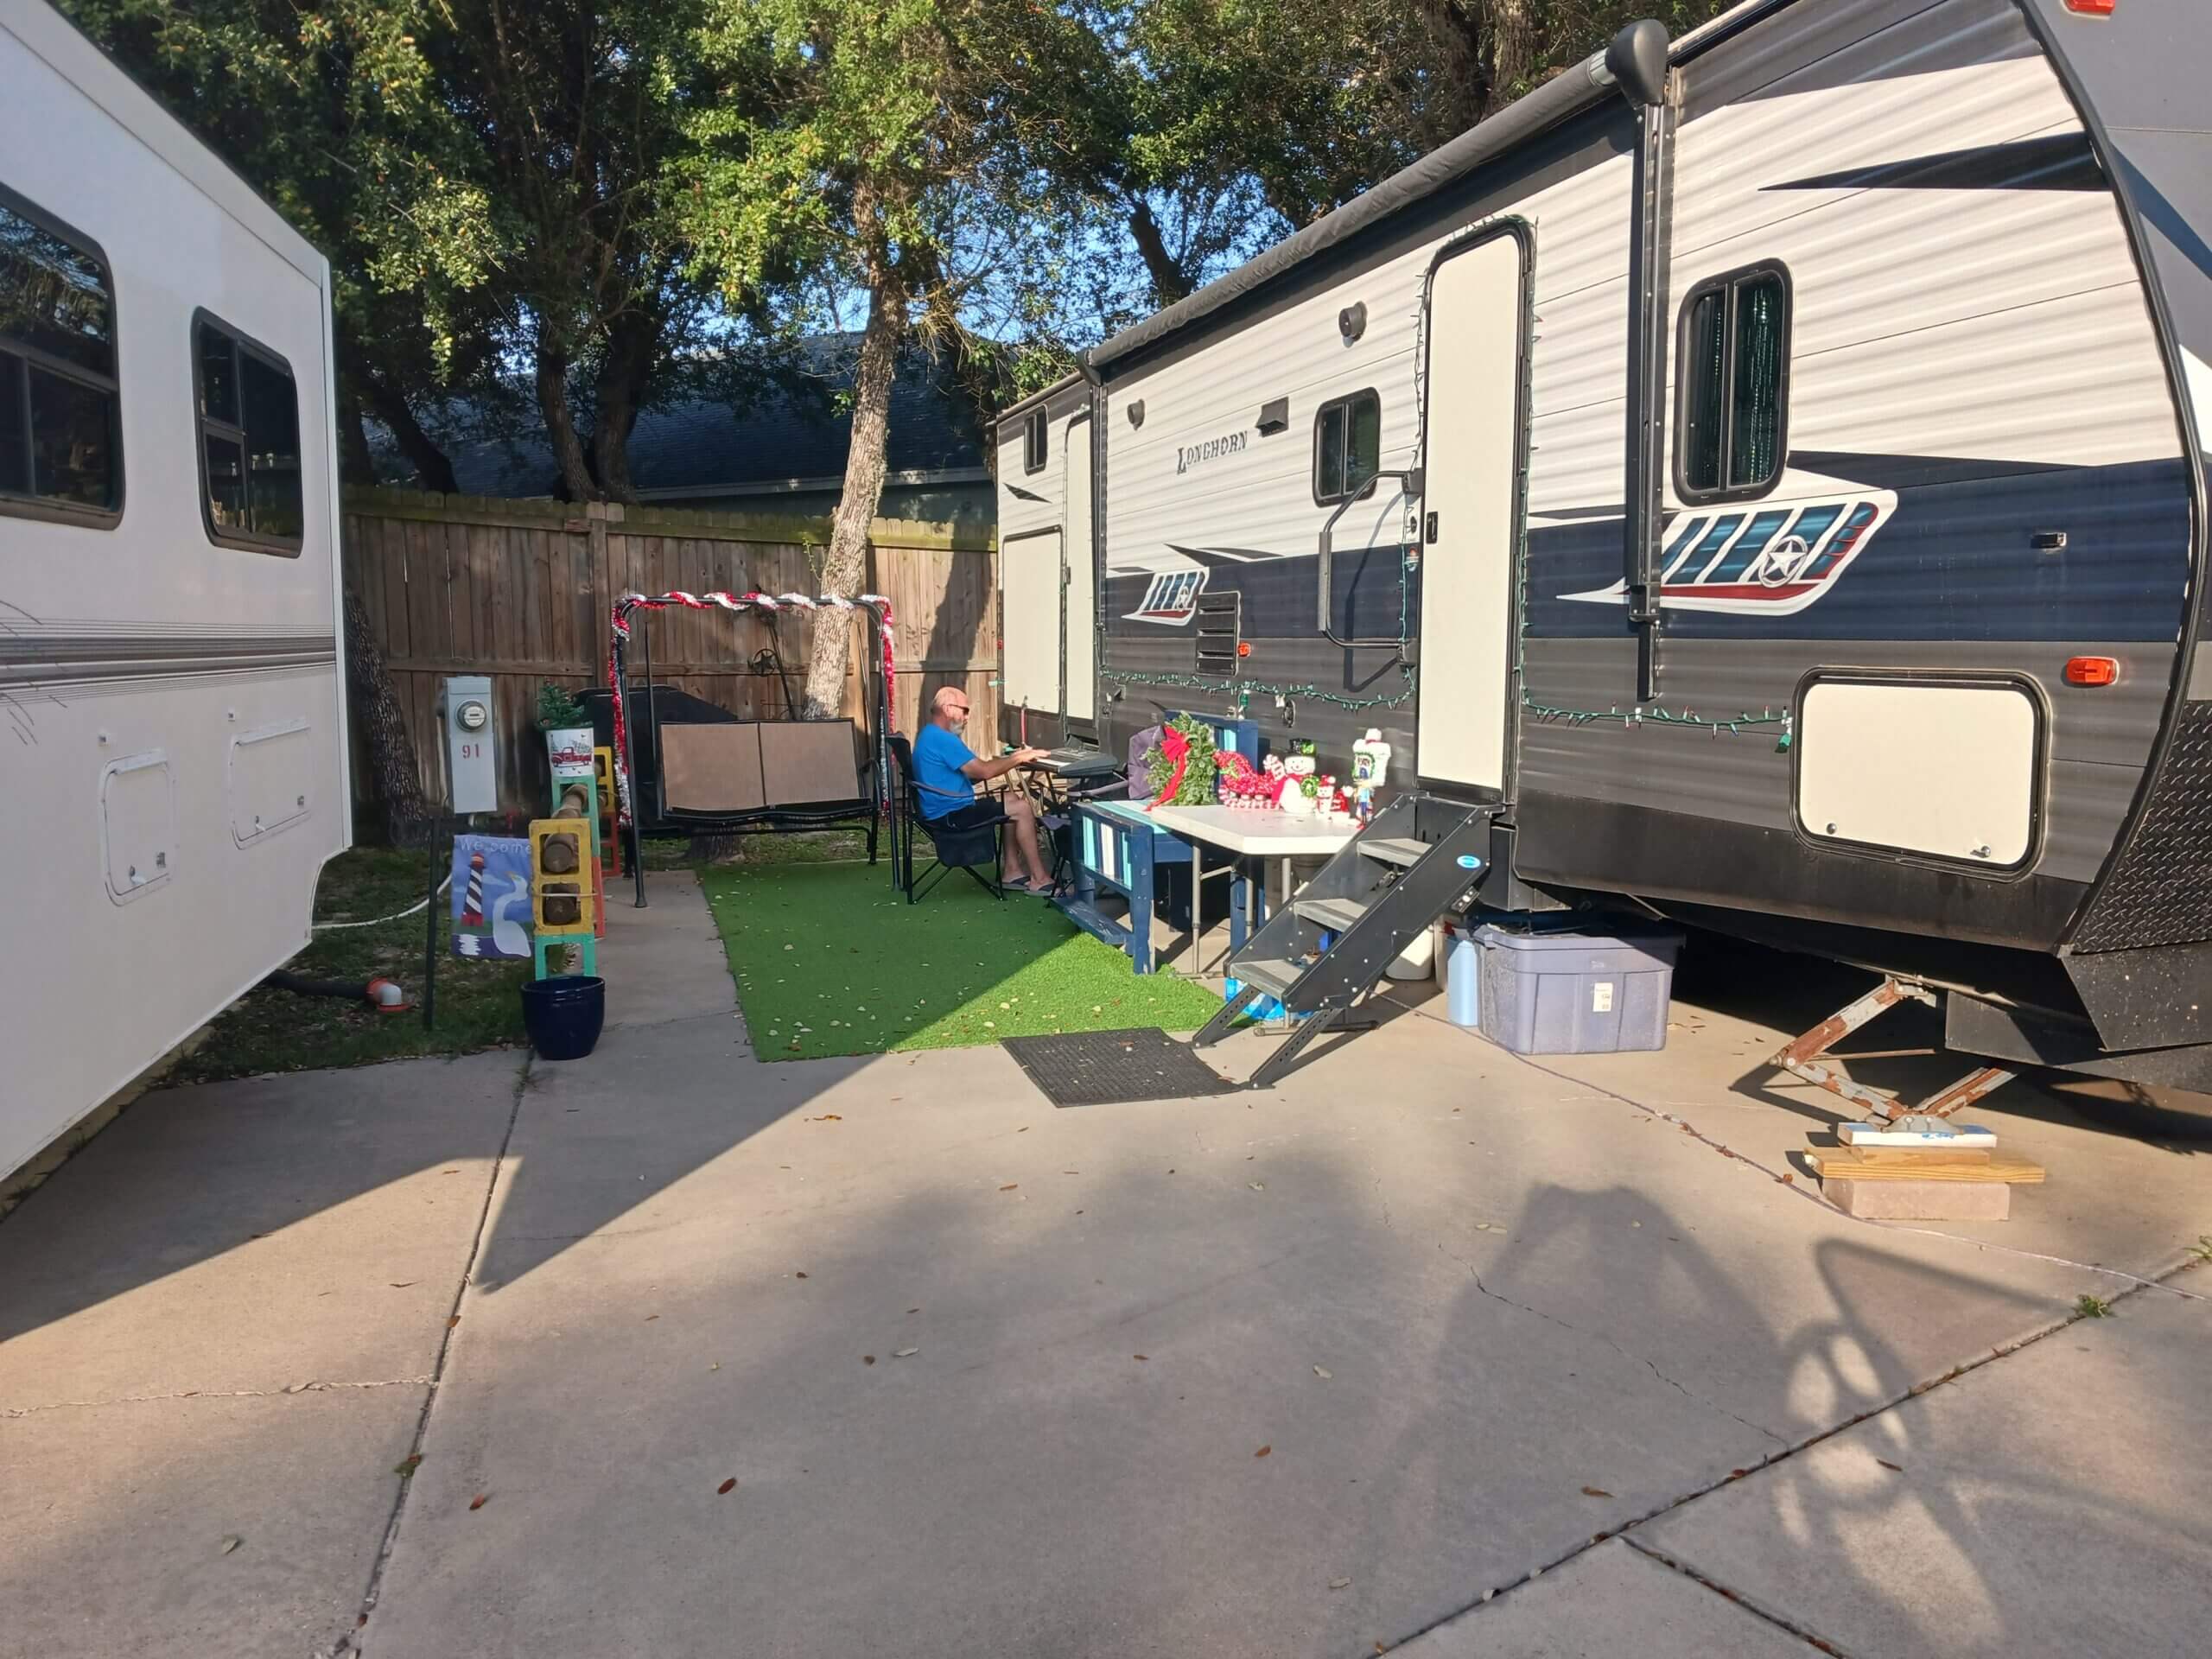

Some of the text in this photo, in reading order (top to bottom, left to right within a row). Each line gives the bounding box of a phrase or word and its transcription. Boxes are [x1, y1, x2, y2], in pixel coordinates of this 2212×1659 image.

[1176, 430, 1248, 475] LONGHORN
[461, 743, 480, 759] 91
[459, 837, 532, 854] Wecome
